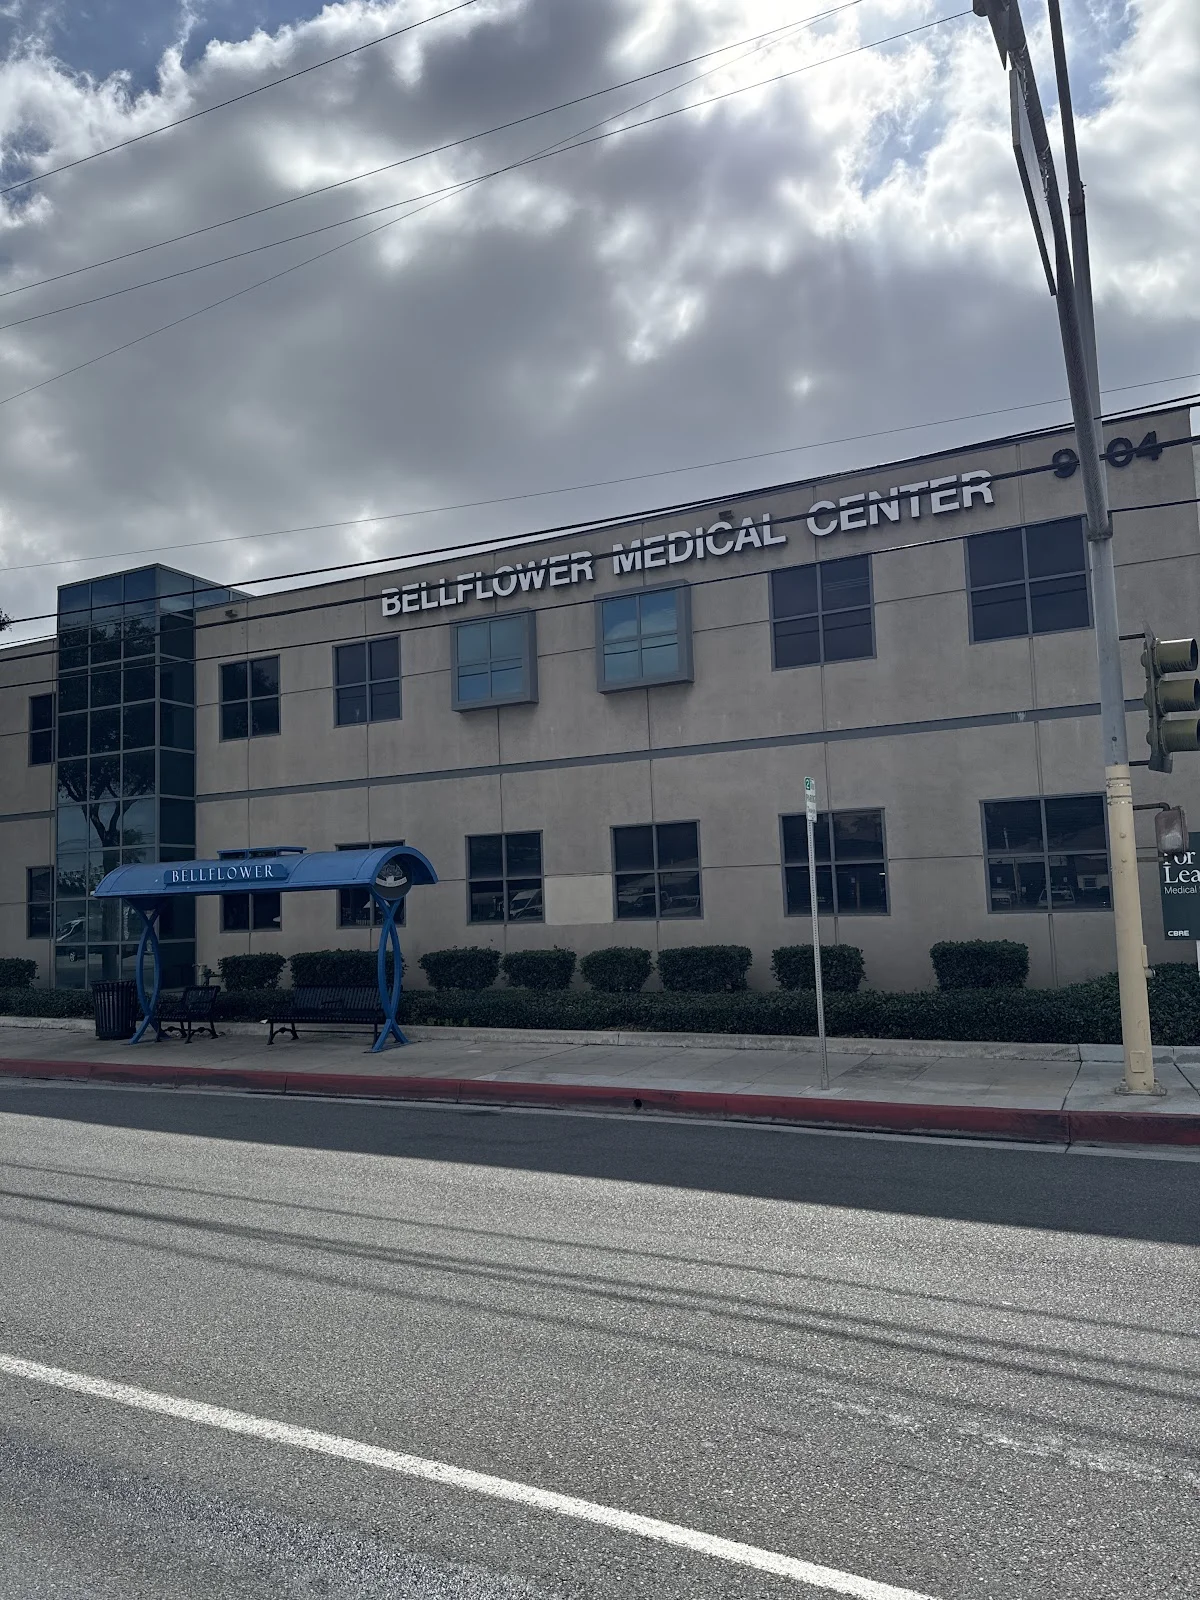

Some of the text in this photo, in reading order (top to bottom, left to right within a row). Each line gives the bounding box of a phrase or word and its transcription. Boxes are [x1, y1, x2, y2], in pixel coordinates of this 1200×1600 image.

[1052, 431, 1163, 478] 904
[381, 469, 994, 617] BELLFLOWER MEDICAL CENTER
[172, 864, 274, 882] BELLFLOWER
[1163, 866, 1200, 883] Lea
[1164, 885, 1197, 894] Medical
